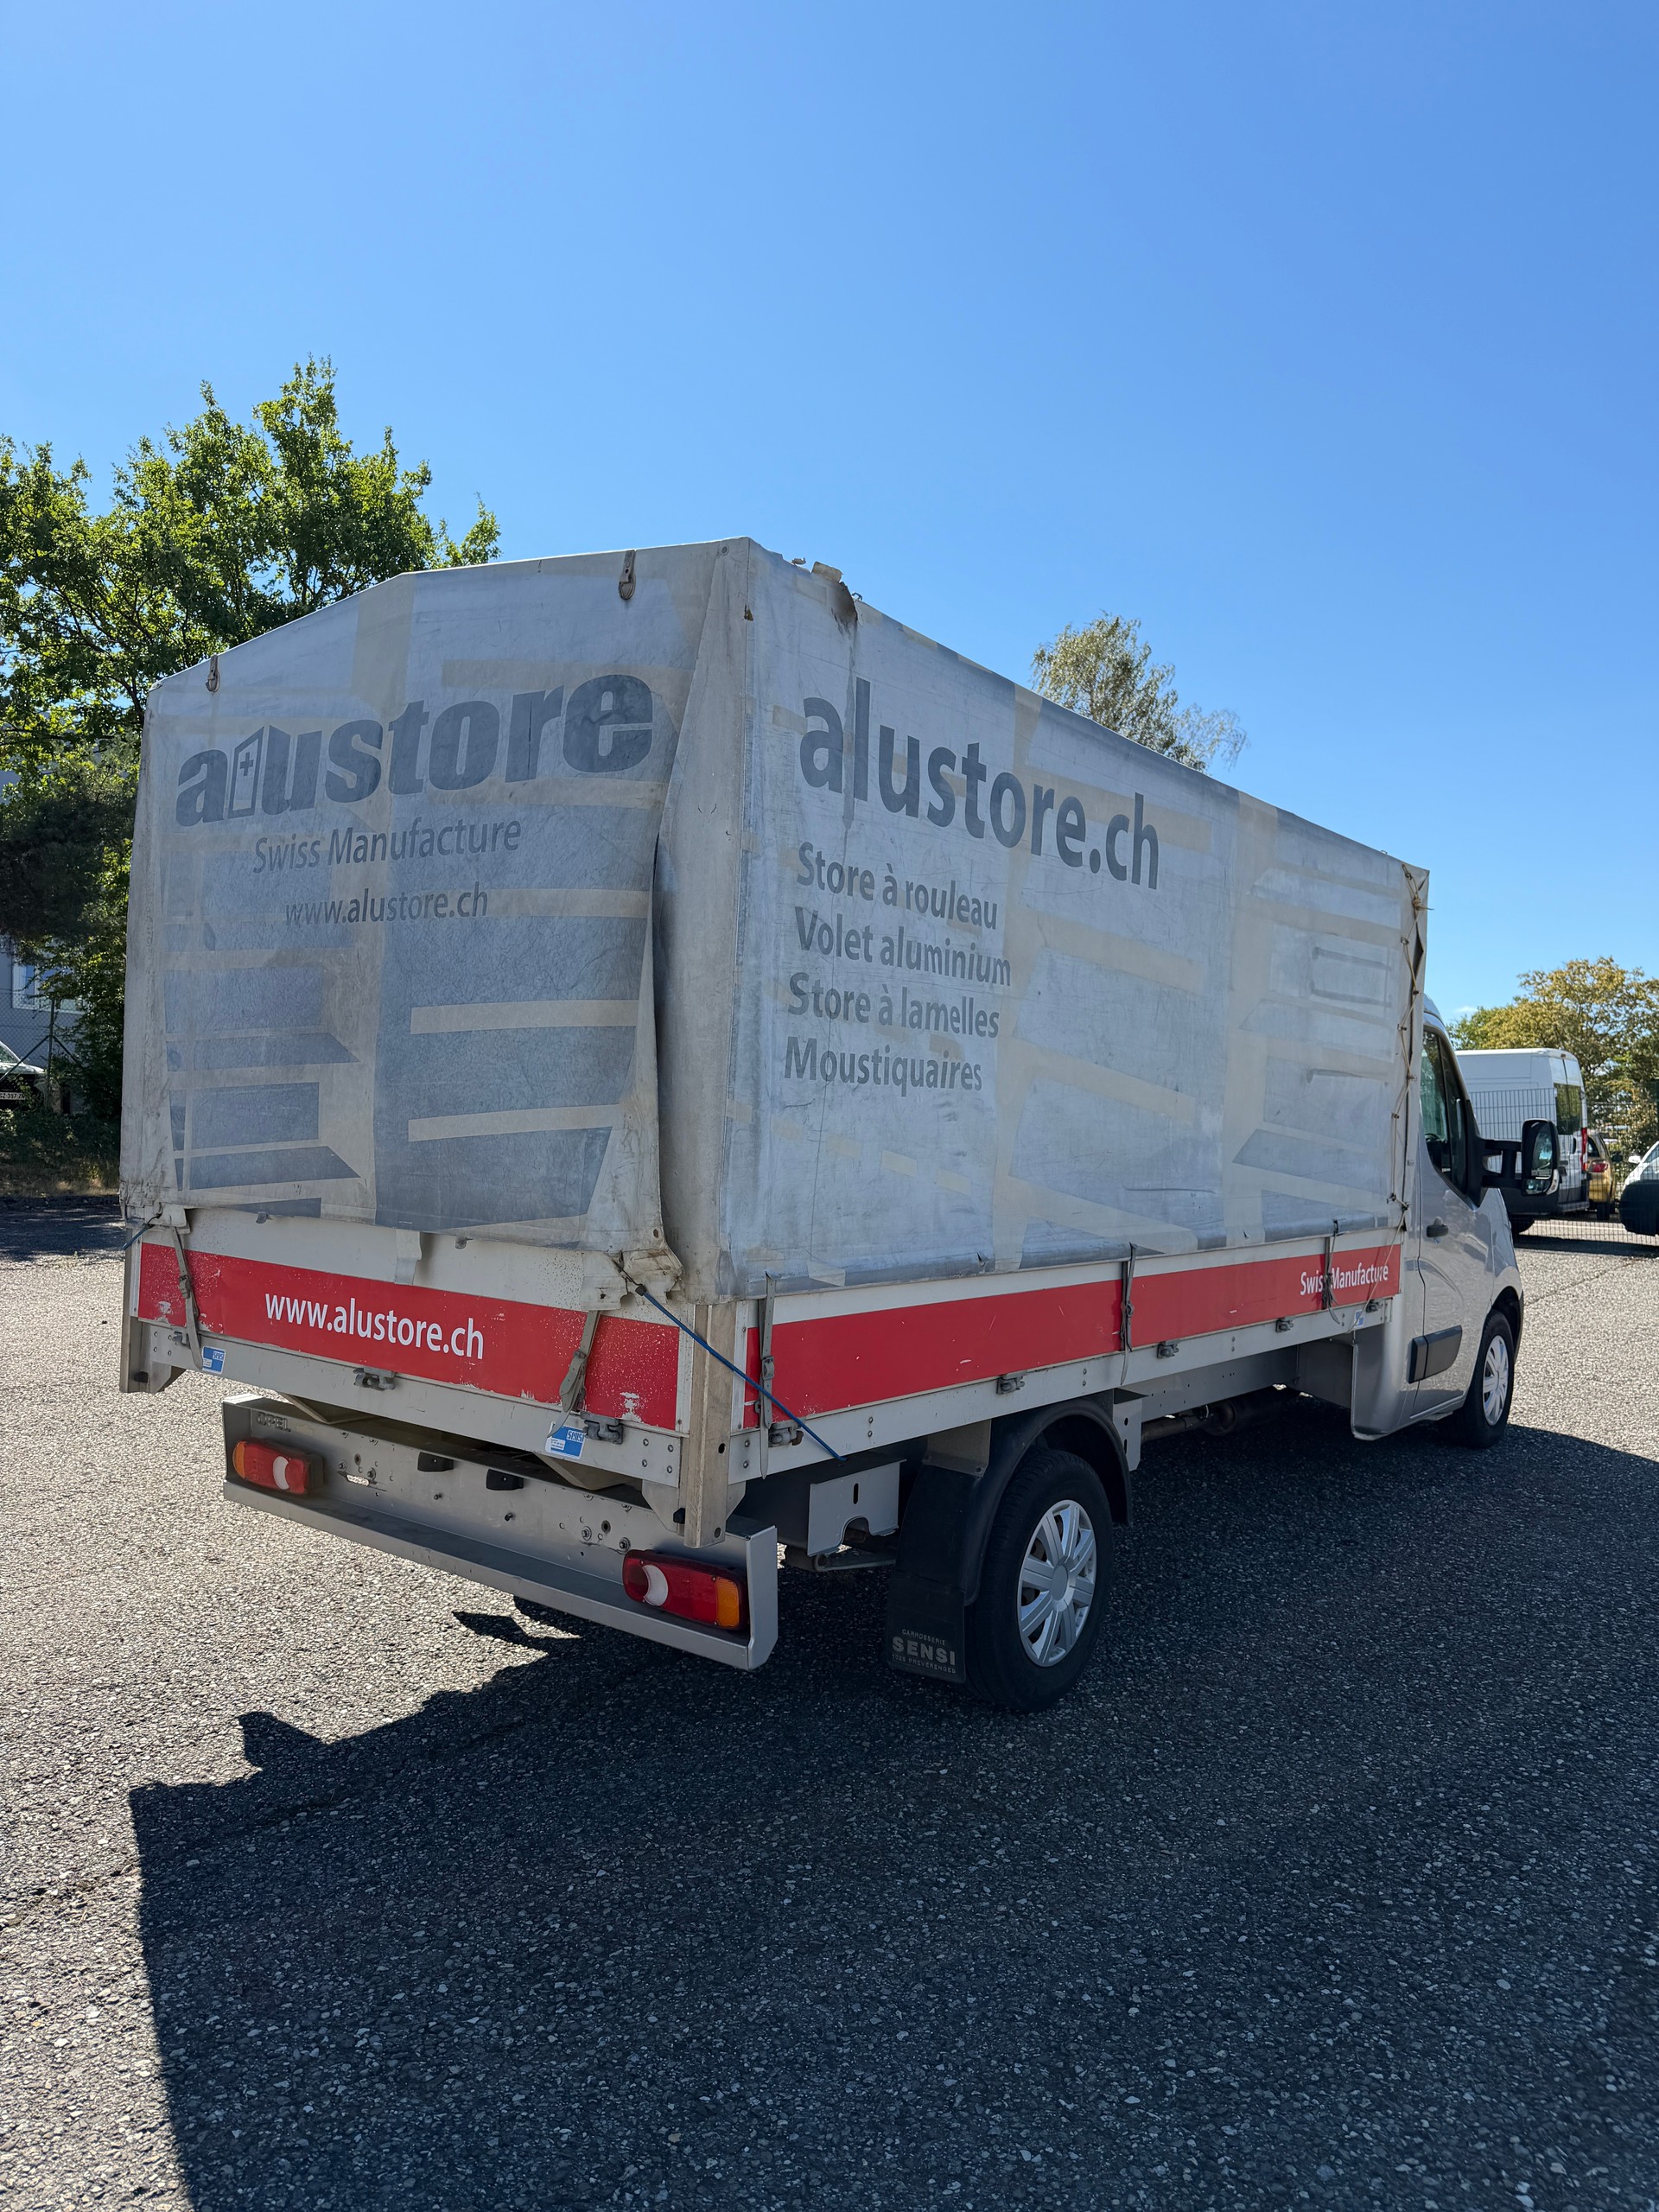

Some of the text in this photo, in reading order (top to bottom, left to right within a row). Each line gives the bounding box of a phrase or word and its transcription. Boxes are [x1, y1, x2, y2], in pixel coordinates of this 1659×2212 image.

[800, 677, 1159, 890] alustore.ch
[253, 817, 521, 874] Swiss Manufacture
[285, 881, 488, 926] www.alustore.ch
[797, 842, 997, 930] Store à rouleau
[794, 906, 1011, 986] Volet aluminium
[788, 972, 1000, 1039] Store à lamelles
[784, 1036, 982, 1097] Moustiquaires
[1300, 1262, 1389, 1295] Swis Manufacture
[265, 1293, 484, 1360] www.alustore.ch
[256, 1411, 291, 1433] OPEL
[892, 1637, 955, 1666] SENSI
